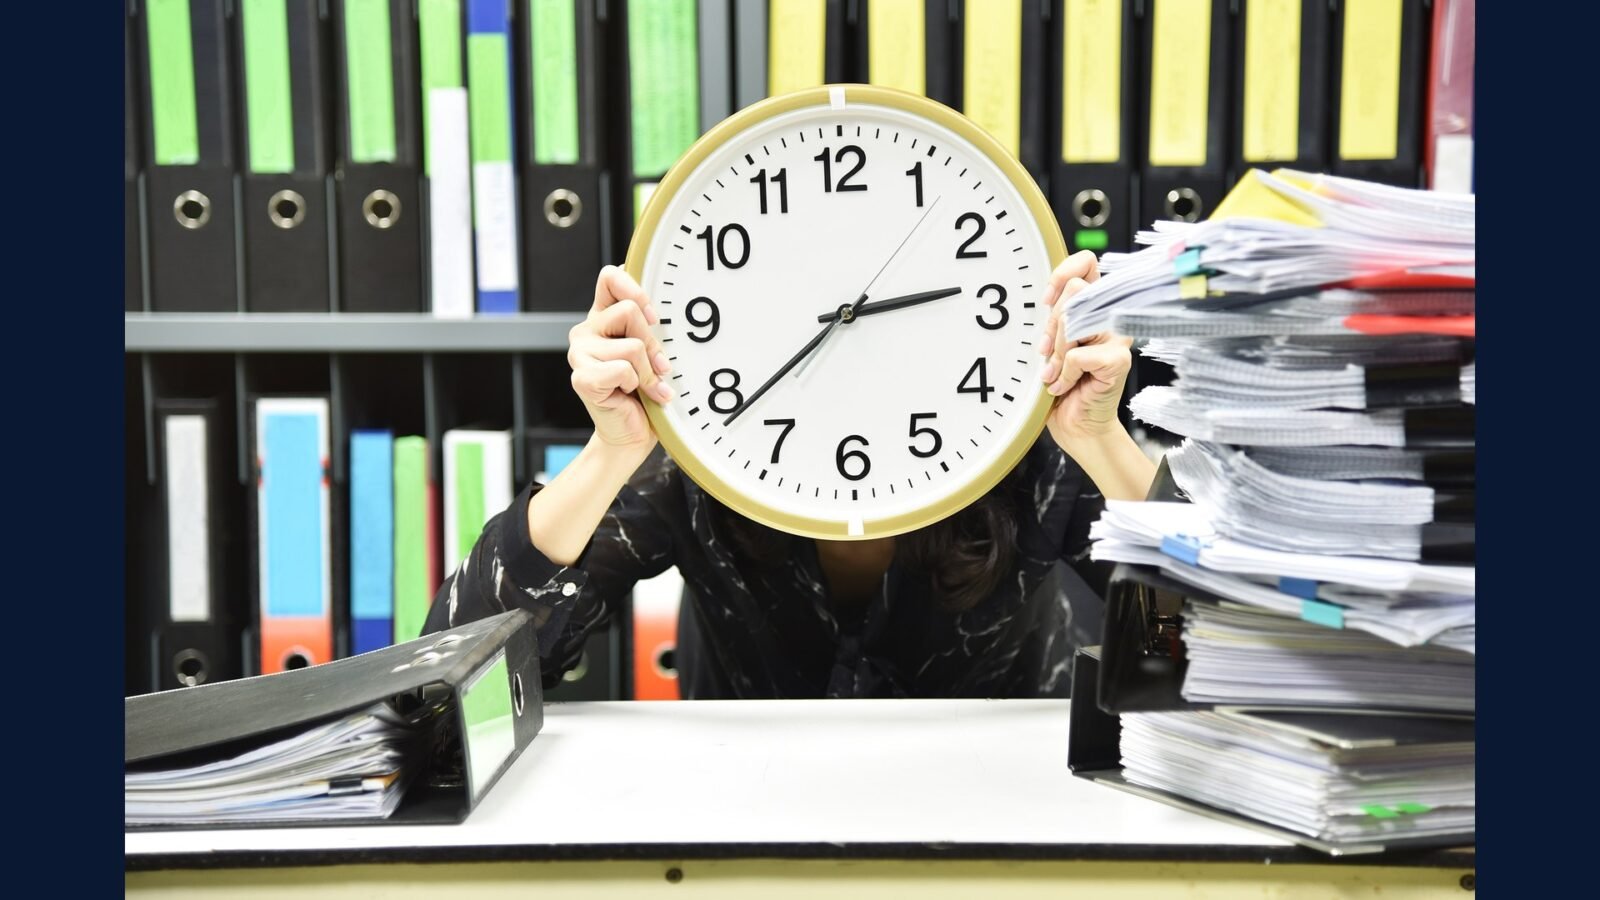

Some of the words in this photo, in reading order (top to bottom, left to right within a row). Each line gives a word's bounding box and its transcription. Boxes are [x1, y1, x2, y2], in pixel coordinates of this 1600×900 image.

[750, 168, 788, 215] 11
[814, 145, 868, 193] 12
[906, 161, 924, 208] 1
[697, 223, 751, 271] 10
[954, 212, 988, 260] 2
[685, 296, 721, 344] 9
[975, 283, 1010, 331] 3
[708, 368, 744, 415] 8
[956, 357, 995, 403] 4
[763, 418, 796, 464] 7
[835, 434, 871, 481] 6
[908, 412, 943, 459] 5
